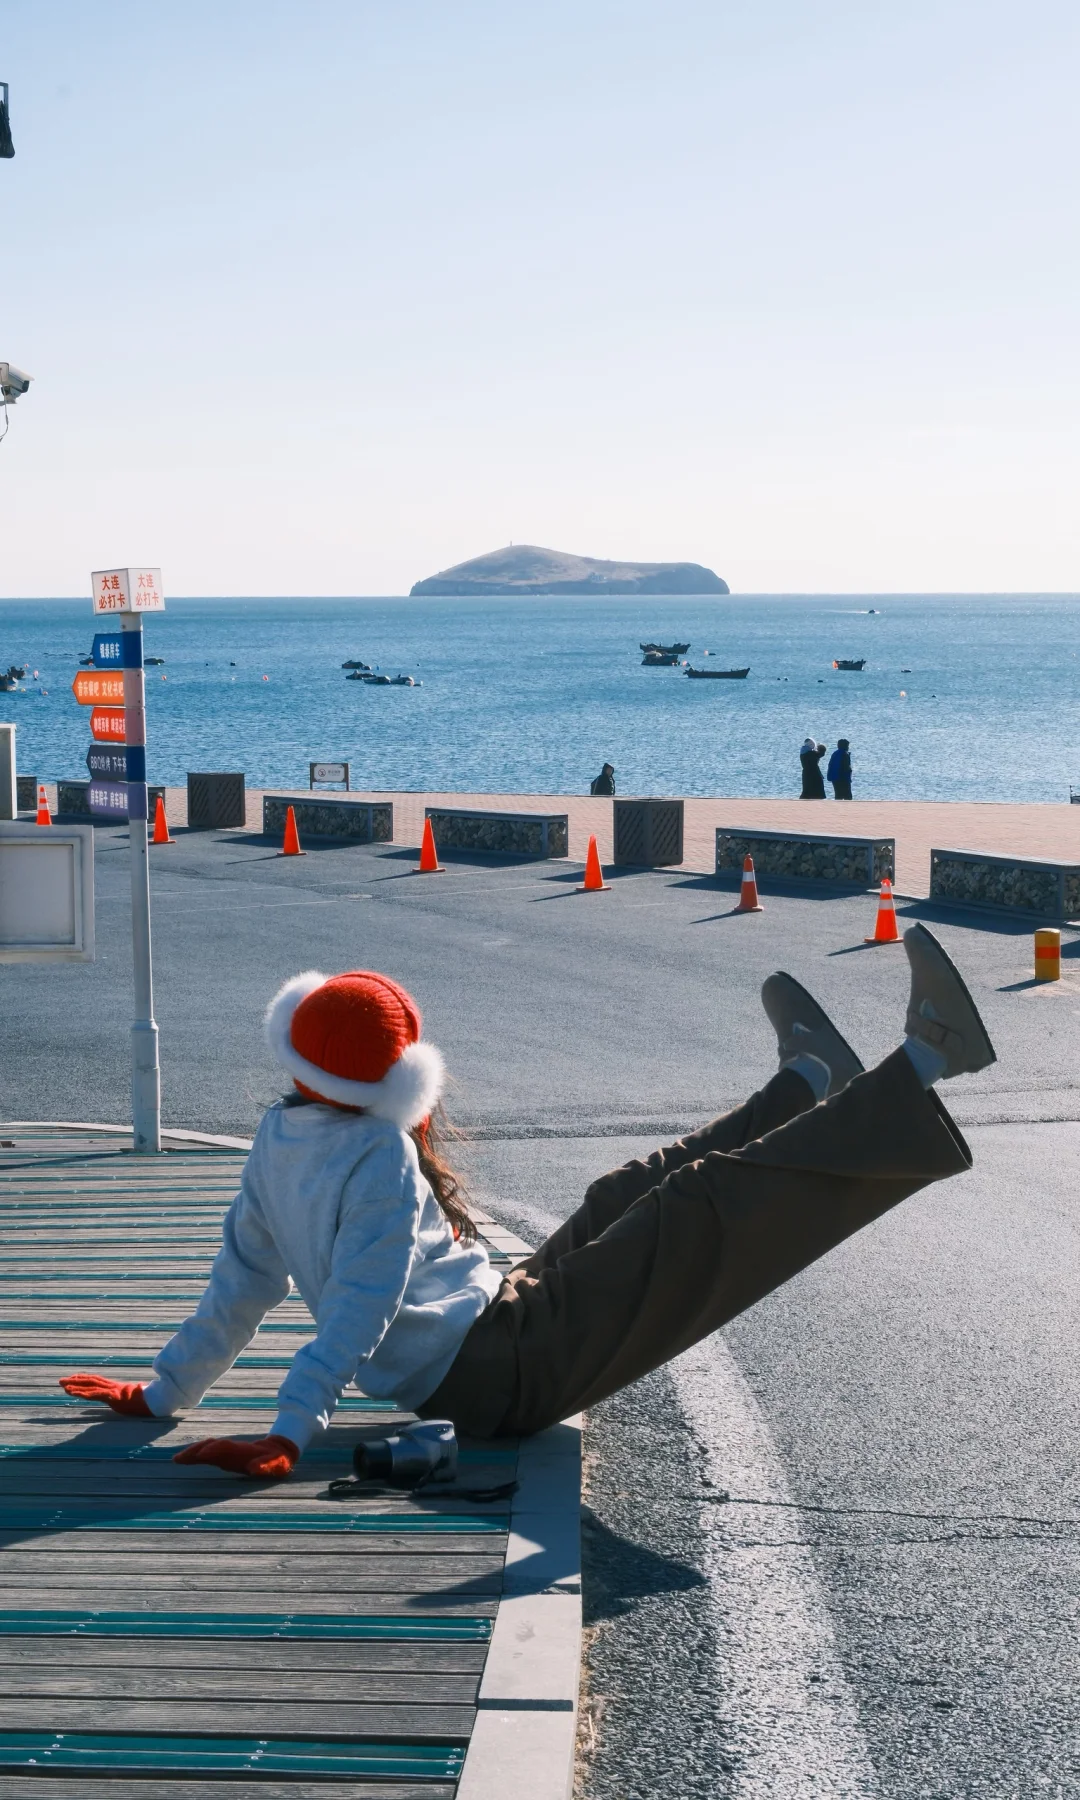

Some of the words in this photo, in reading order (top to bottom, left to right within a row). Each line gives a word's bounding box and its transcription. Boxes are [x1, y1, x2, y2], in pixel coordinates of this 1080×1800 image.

[102, 575, 120, 591] 大连
[137, 574, 154, 588] 大连
[99, 592, 126, 609] 必打卡
[135, 591, 159, 607] 必打卡
[90, 756, 110, 771] BBQ烧烤
